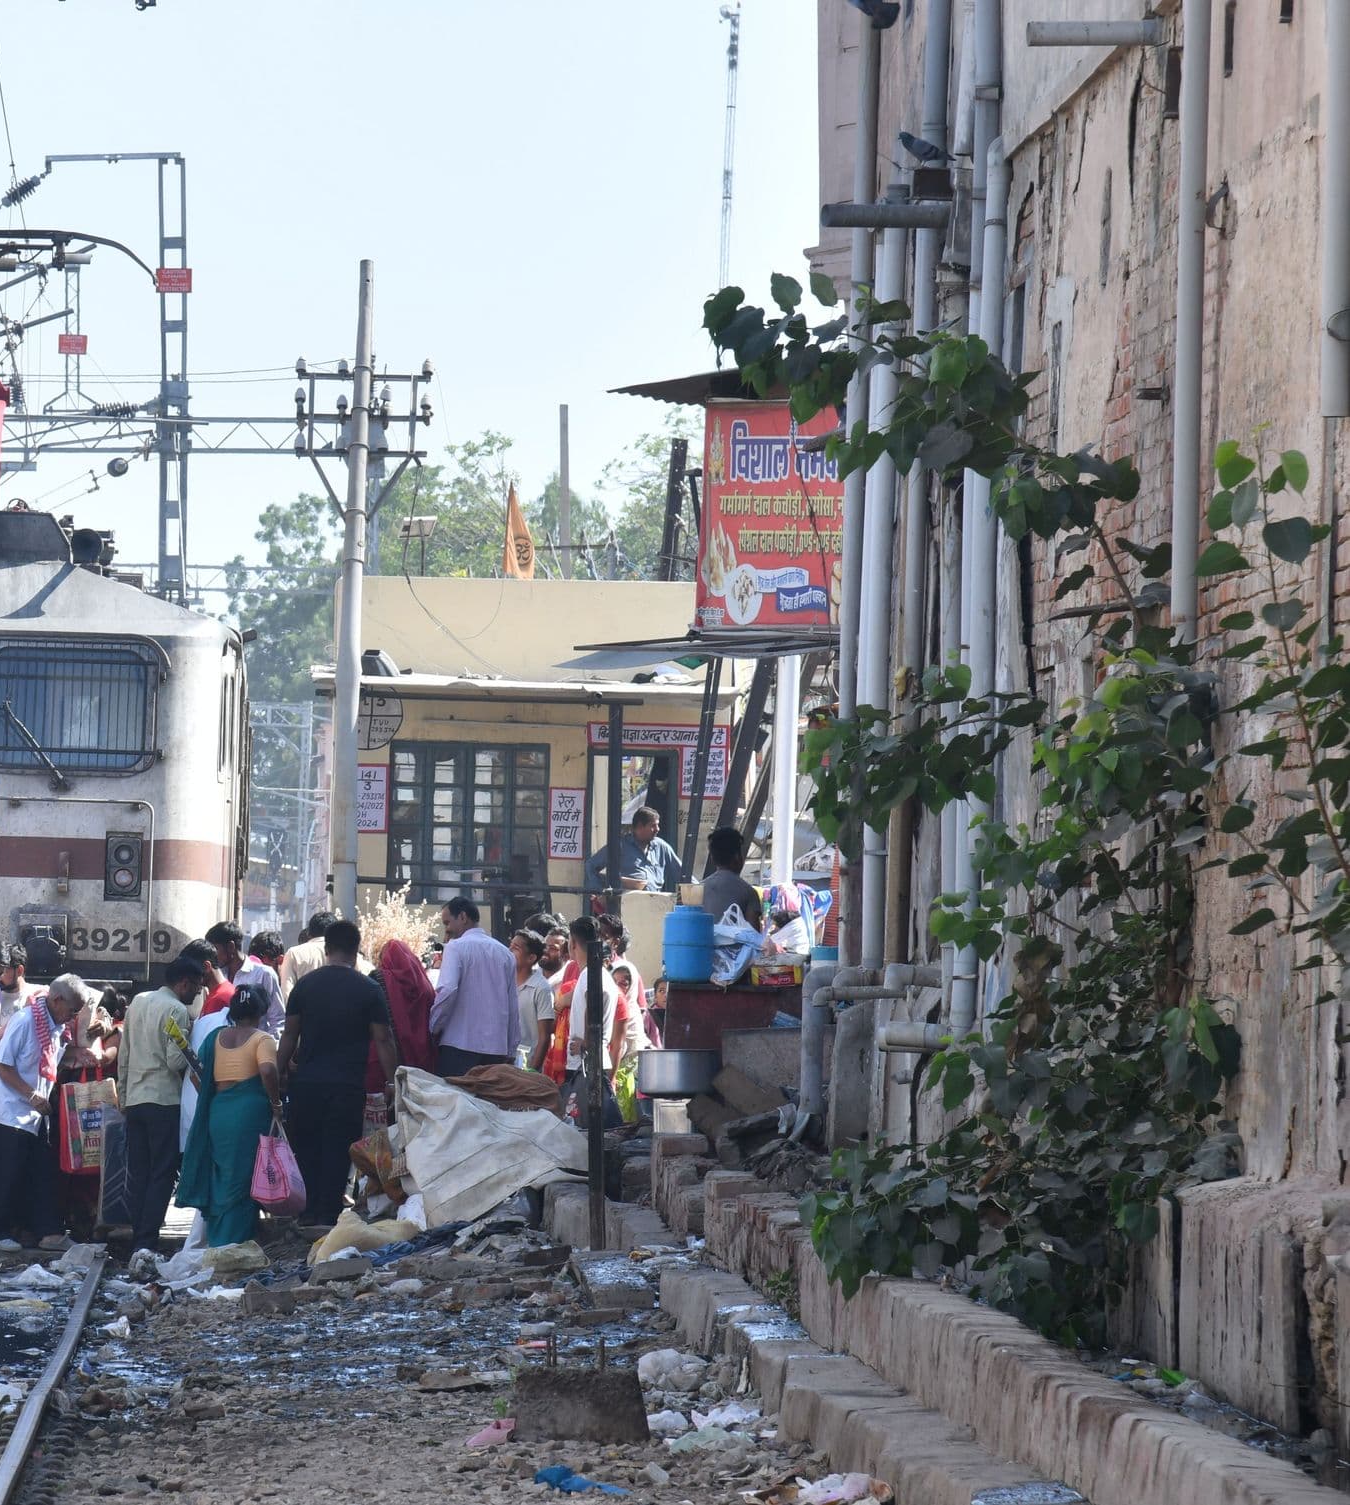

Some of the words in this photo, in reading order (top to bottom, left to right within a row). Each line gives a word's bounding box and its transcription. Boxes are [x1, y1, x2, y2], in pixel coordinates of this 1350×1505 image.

[730, 420, 791, 483] विशाल
[719, 489, 753, 515] गर्मागर्म
[753, 496, 772, 516] दाल
[759, 530, 775, 553] दाल
[361, 770, 378, 780] 141
[363, 781, 372, 791] 3
[557, 792, 577, 809] रेल
[551, 808, 572, 822] कार्य
[554, 825, 581, 841] बाधा
[551, 841, 562, 853] न
[72, 926, 172, 954] 39219
